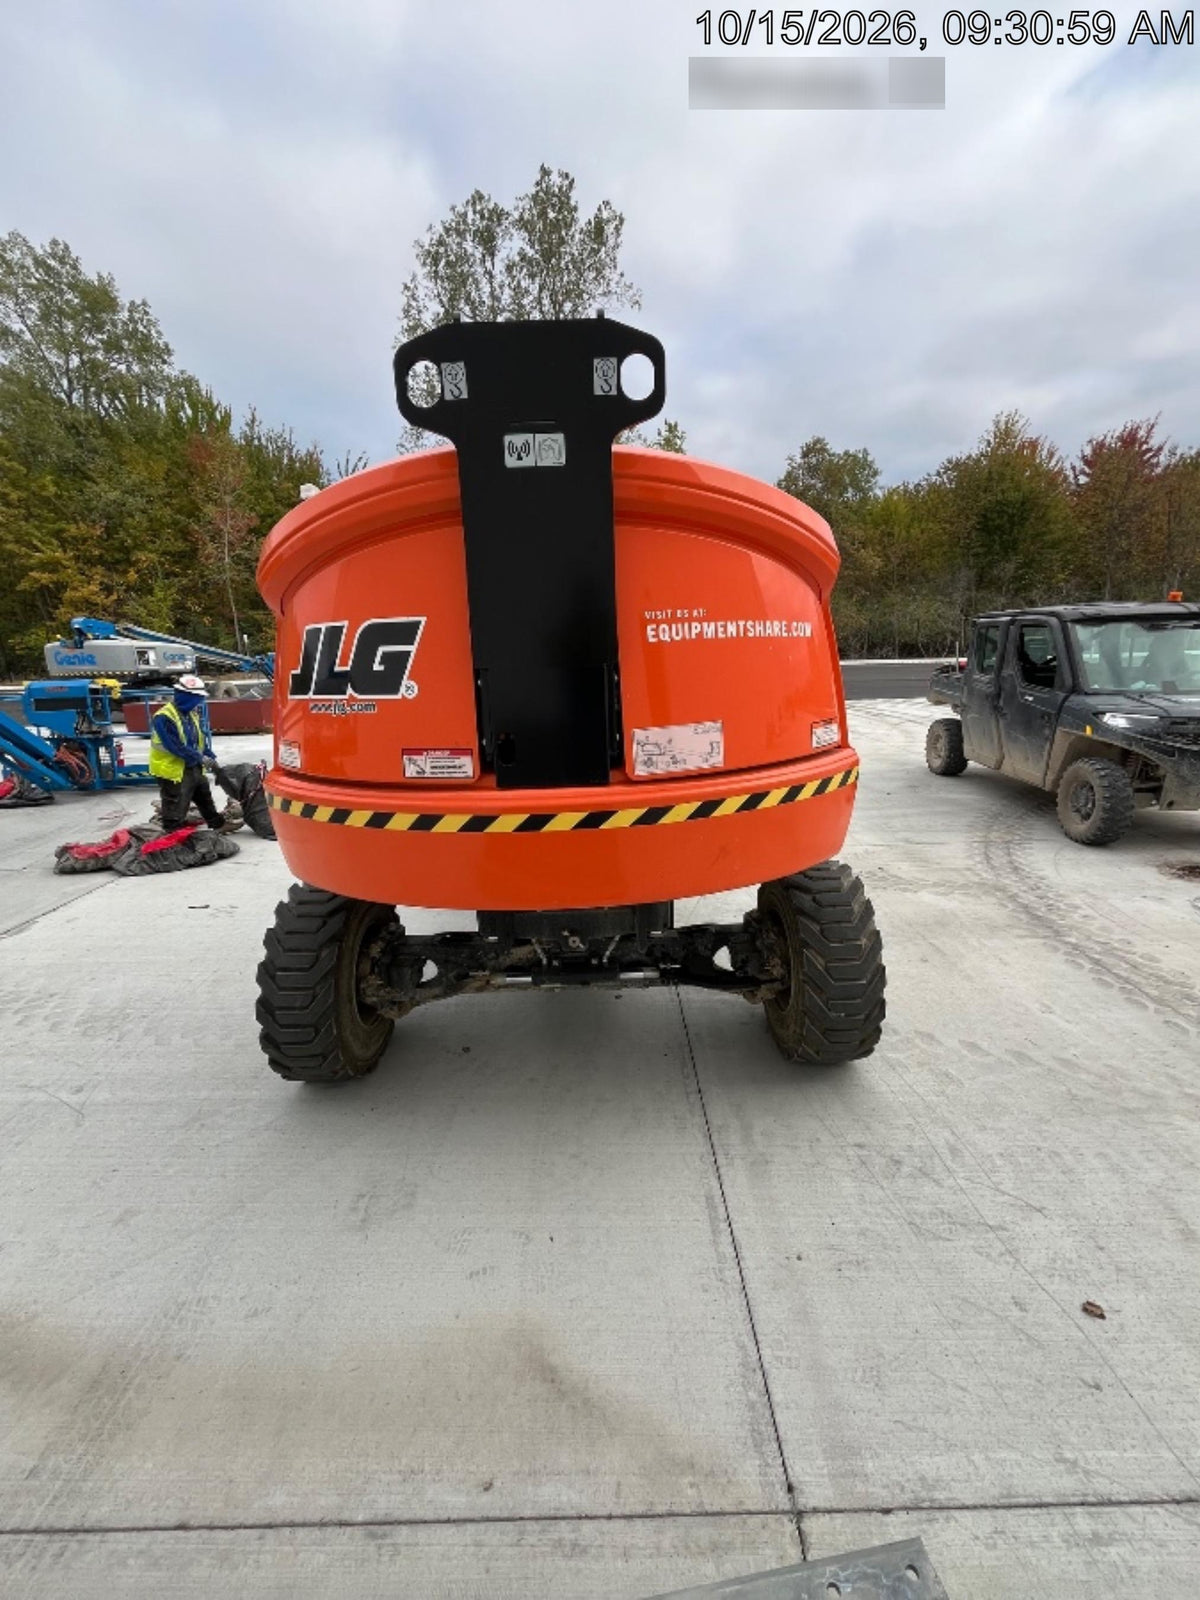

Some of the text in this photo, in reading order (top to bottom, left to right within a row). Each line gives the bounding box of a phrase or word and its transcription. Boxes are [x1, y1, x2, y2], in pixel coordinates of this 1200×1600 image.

[645, 609, 672, 620] VISIT
[646, 621, 812, 642] EQUIPMENTSHARE.COM
[54, 651, 97, 666] Genie
[288, 616, 427, 700] JLG
[309, 700, 377, 716] www.jlg.com
